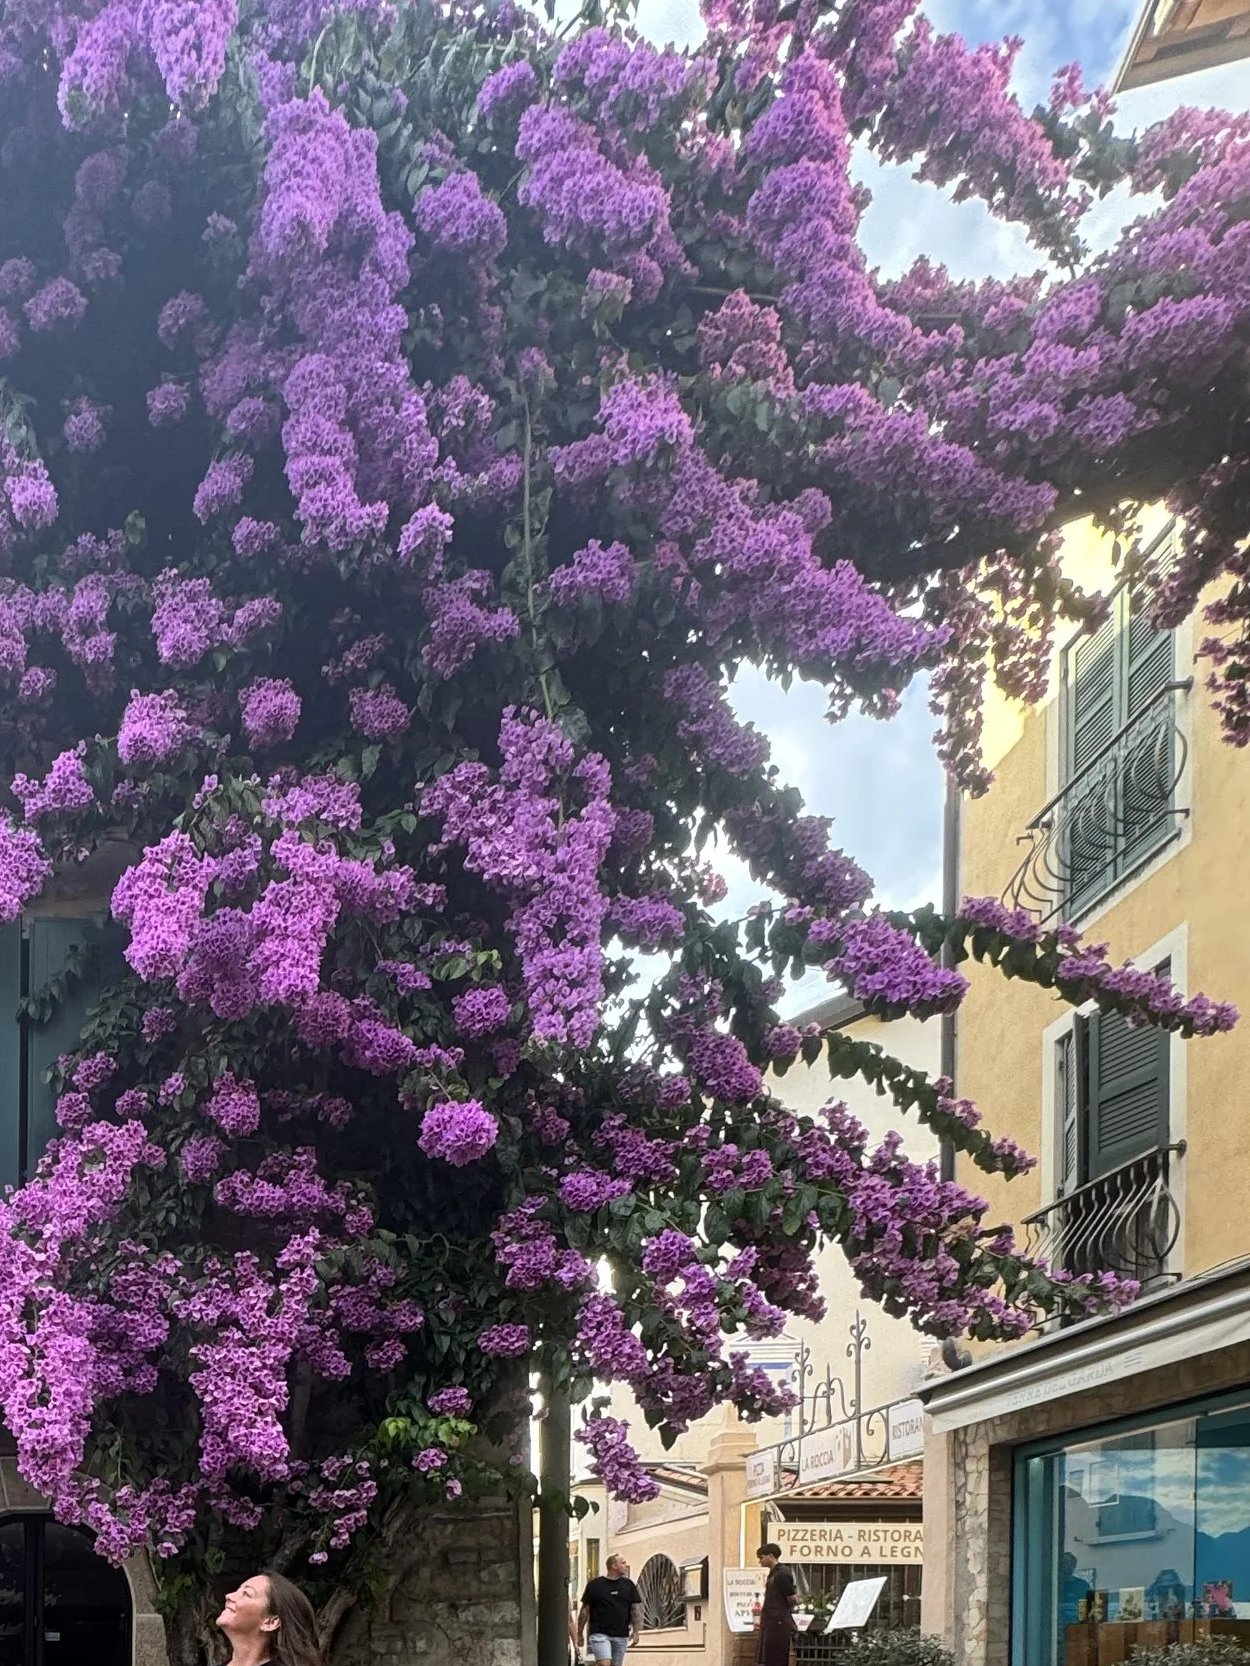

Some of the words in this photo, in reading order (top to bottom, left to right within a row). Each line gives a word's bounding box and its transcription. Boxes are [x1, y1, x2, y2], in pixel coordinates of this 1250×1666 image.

[1067, 1362, 1113, 1386] GARDA
[812, 1449, 834, 1468] ROCCIA
[778, 1529, 844, 1542] PIZZERIA
[857, 1529, 923, 1543] RISTORA
[789, 1545, 853, 1557] FORNO
[860, 1546, 872, 1557] A
